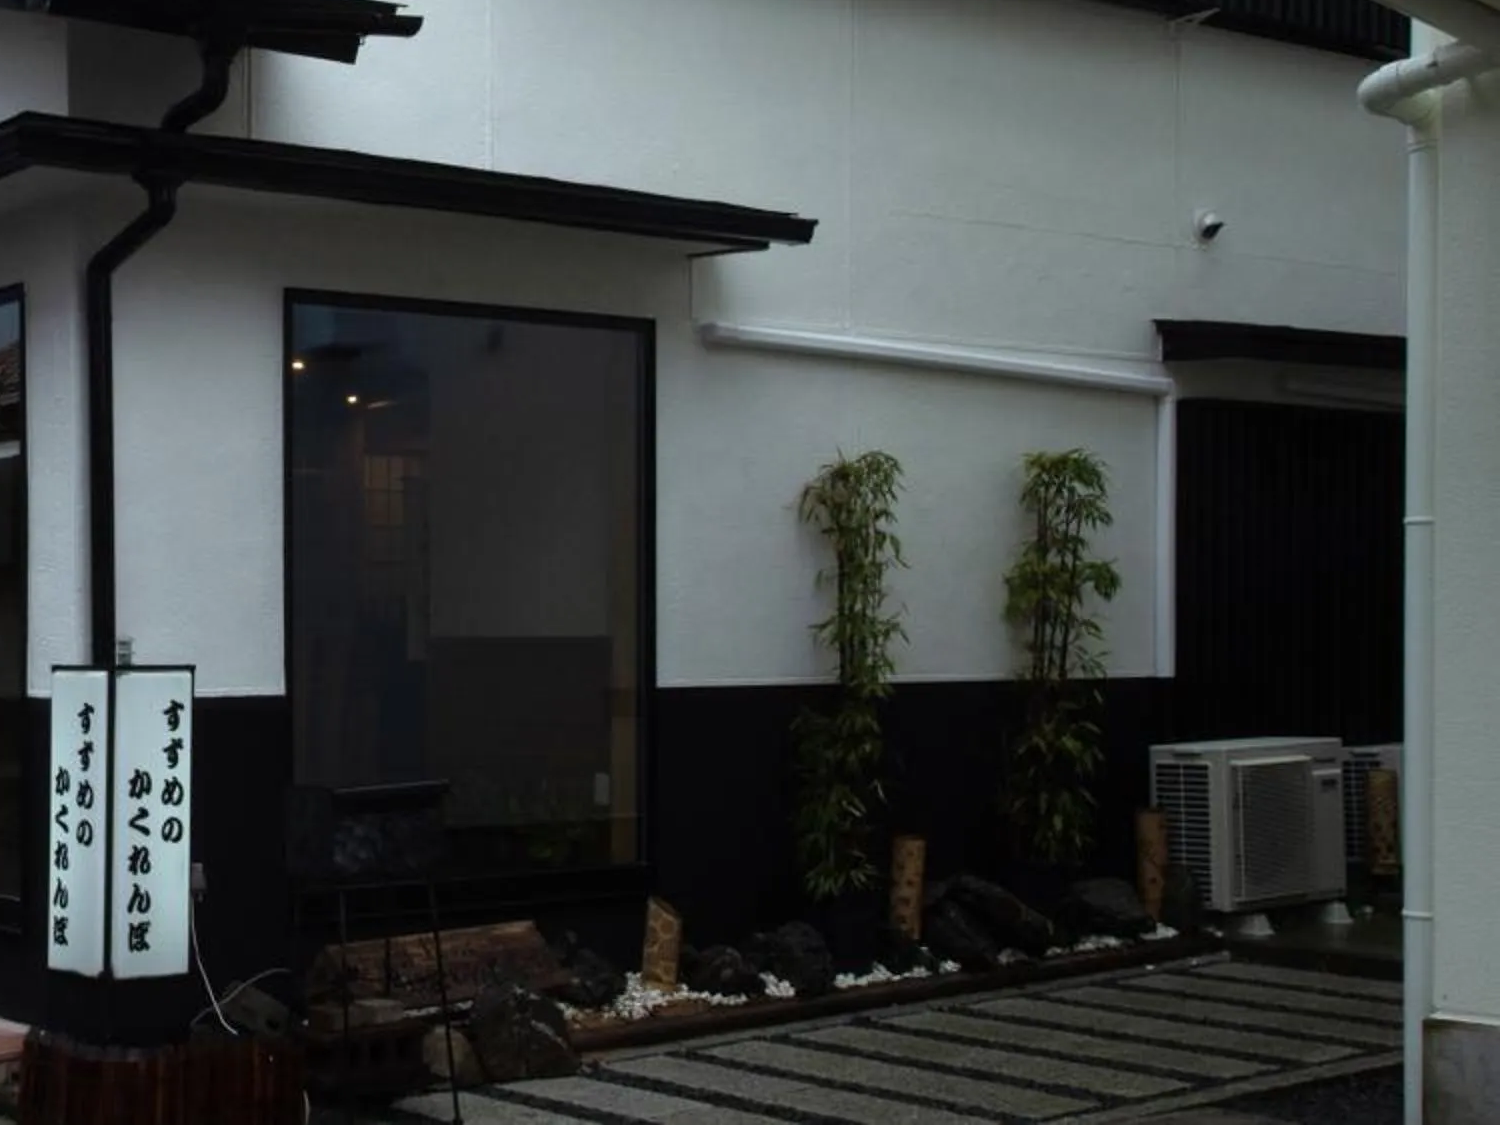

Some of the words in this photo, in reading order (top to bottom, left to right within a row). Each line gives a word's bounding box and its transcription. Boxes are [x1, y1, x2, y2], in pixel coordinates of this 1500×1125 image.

[76, 702, 95, 847] すずめの
[161, 699, 185, 844] すずめの
[127, 768, 152, 953] かくれんぼ
